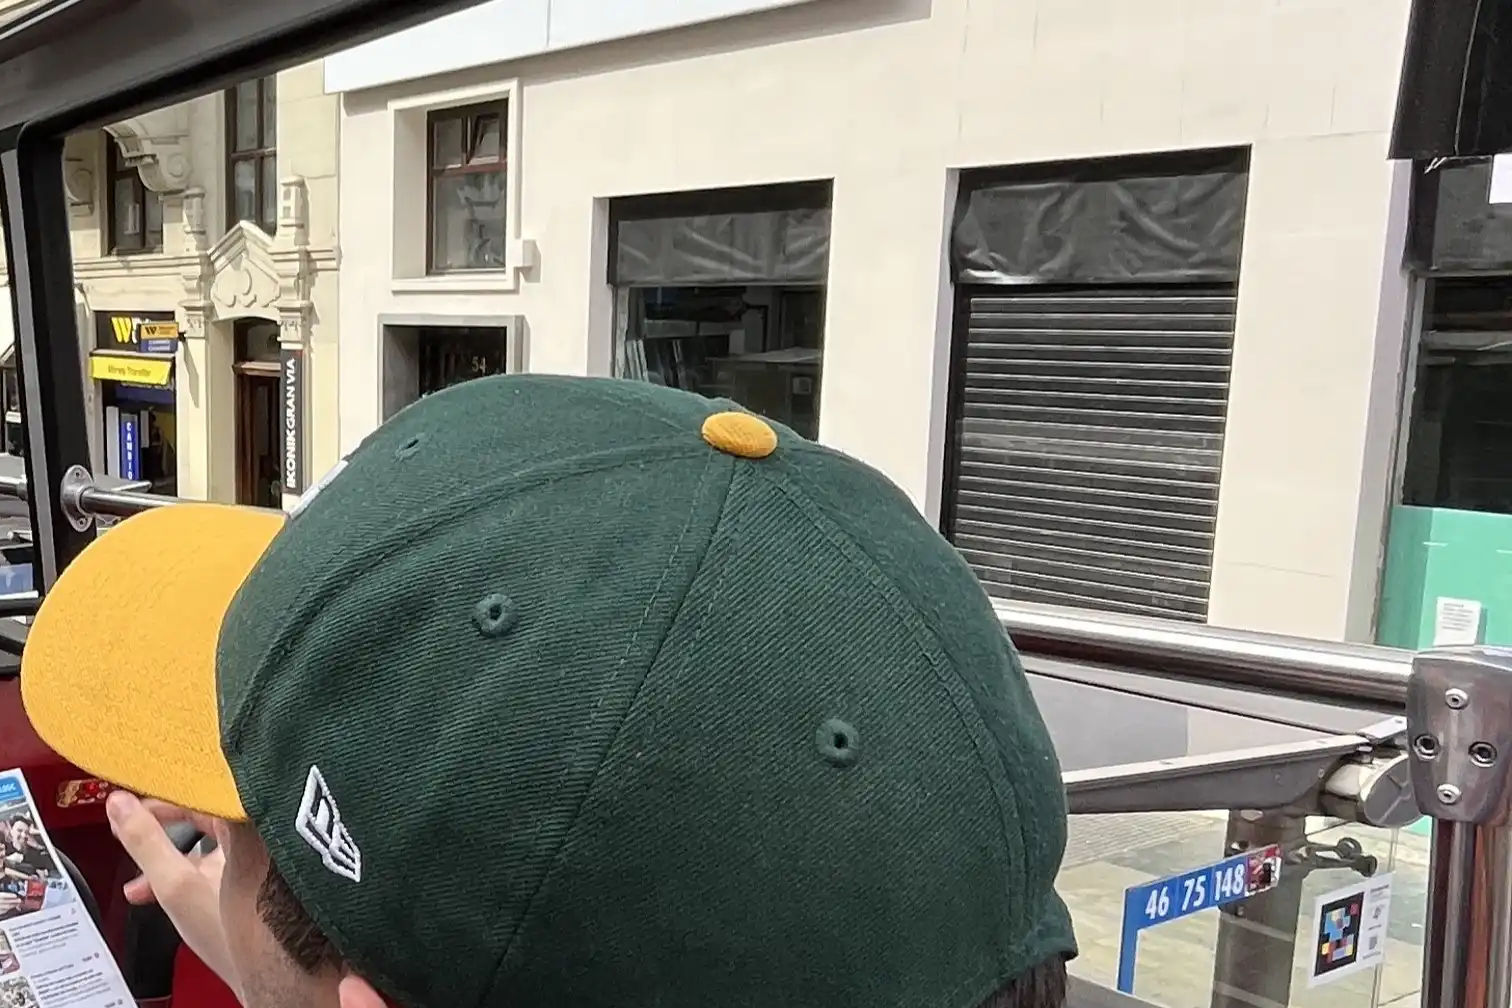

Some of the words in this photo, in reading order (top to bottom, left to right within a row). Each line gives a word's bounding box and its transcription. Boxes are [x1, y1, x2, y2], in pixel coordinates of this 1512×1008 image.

[286, 358, 296, 385] VIA
[286, 386, 296, 429] GRAN
[1145, 886, 1170, 920] 46
[1182, 875, 1206, 911] 75
[1213, 863, 1245, 902] 148
